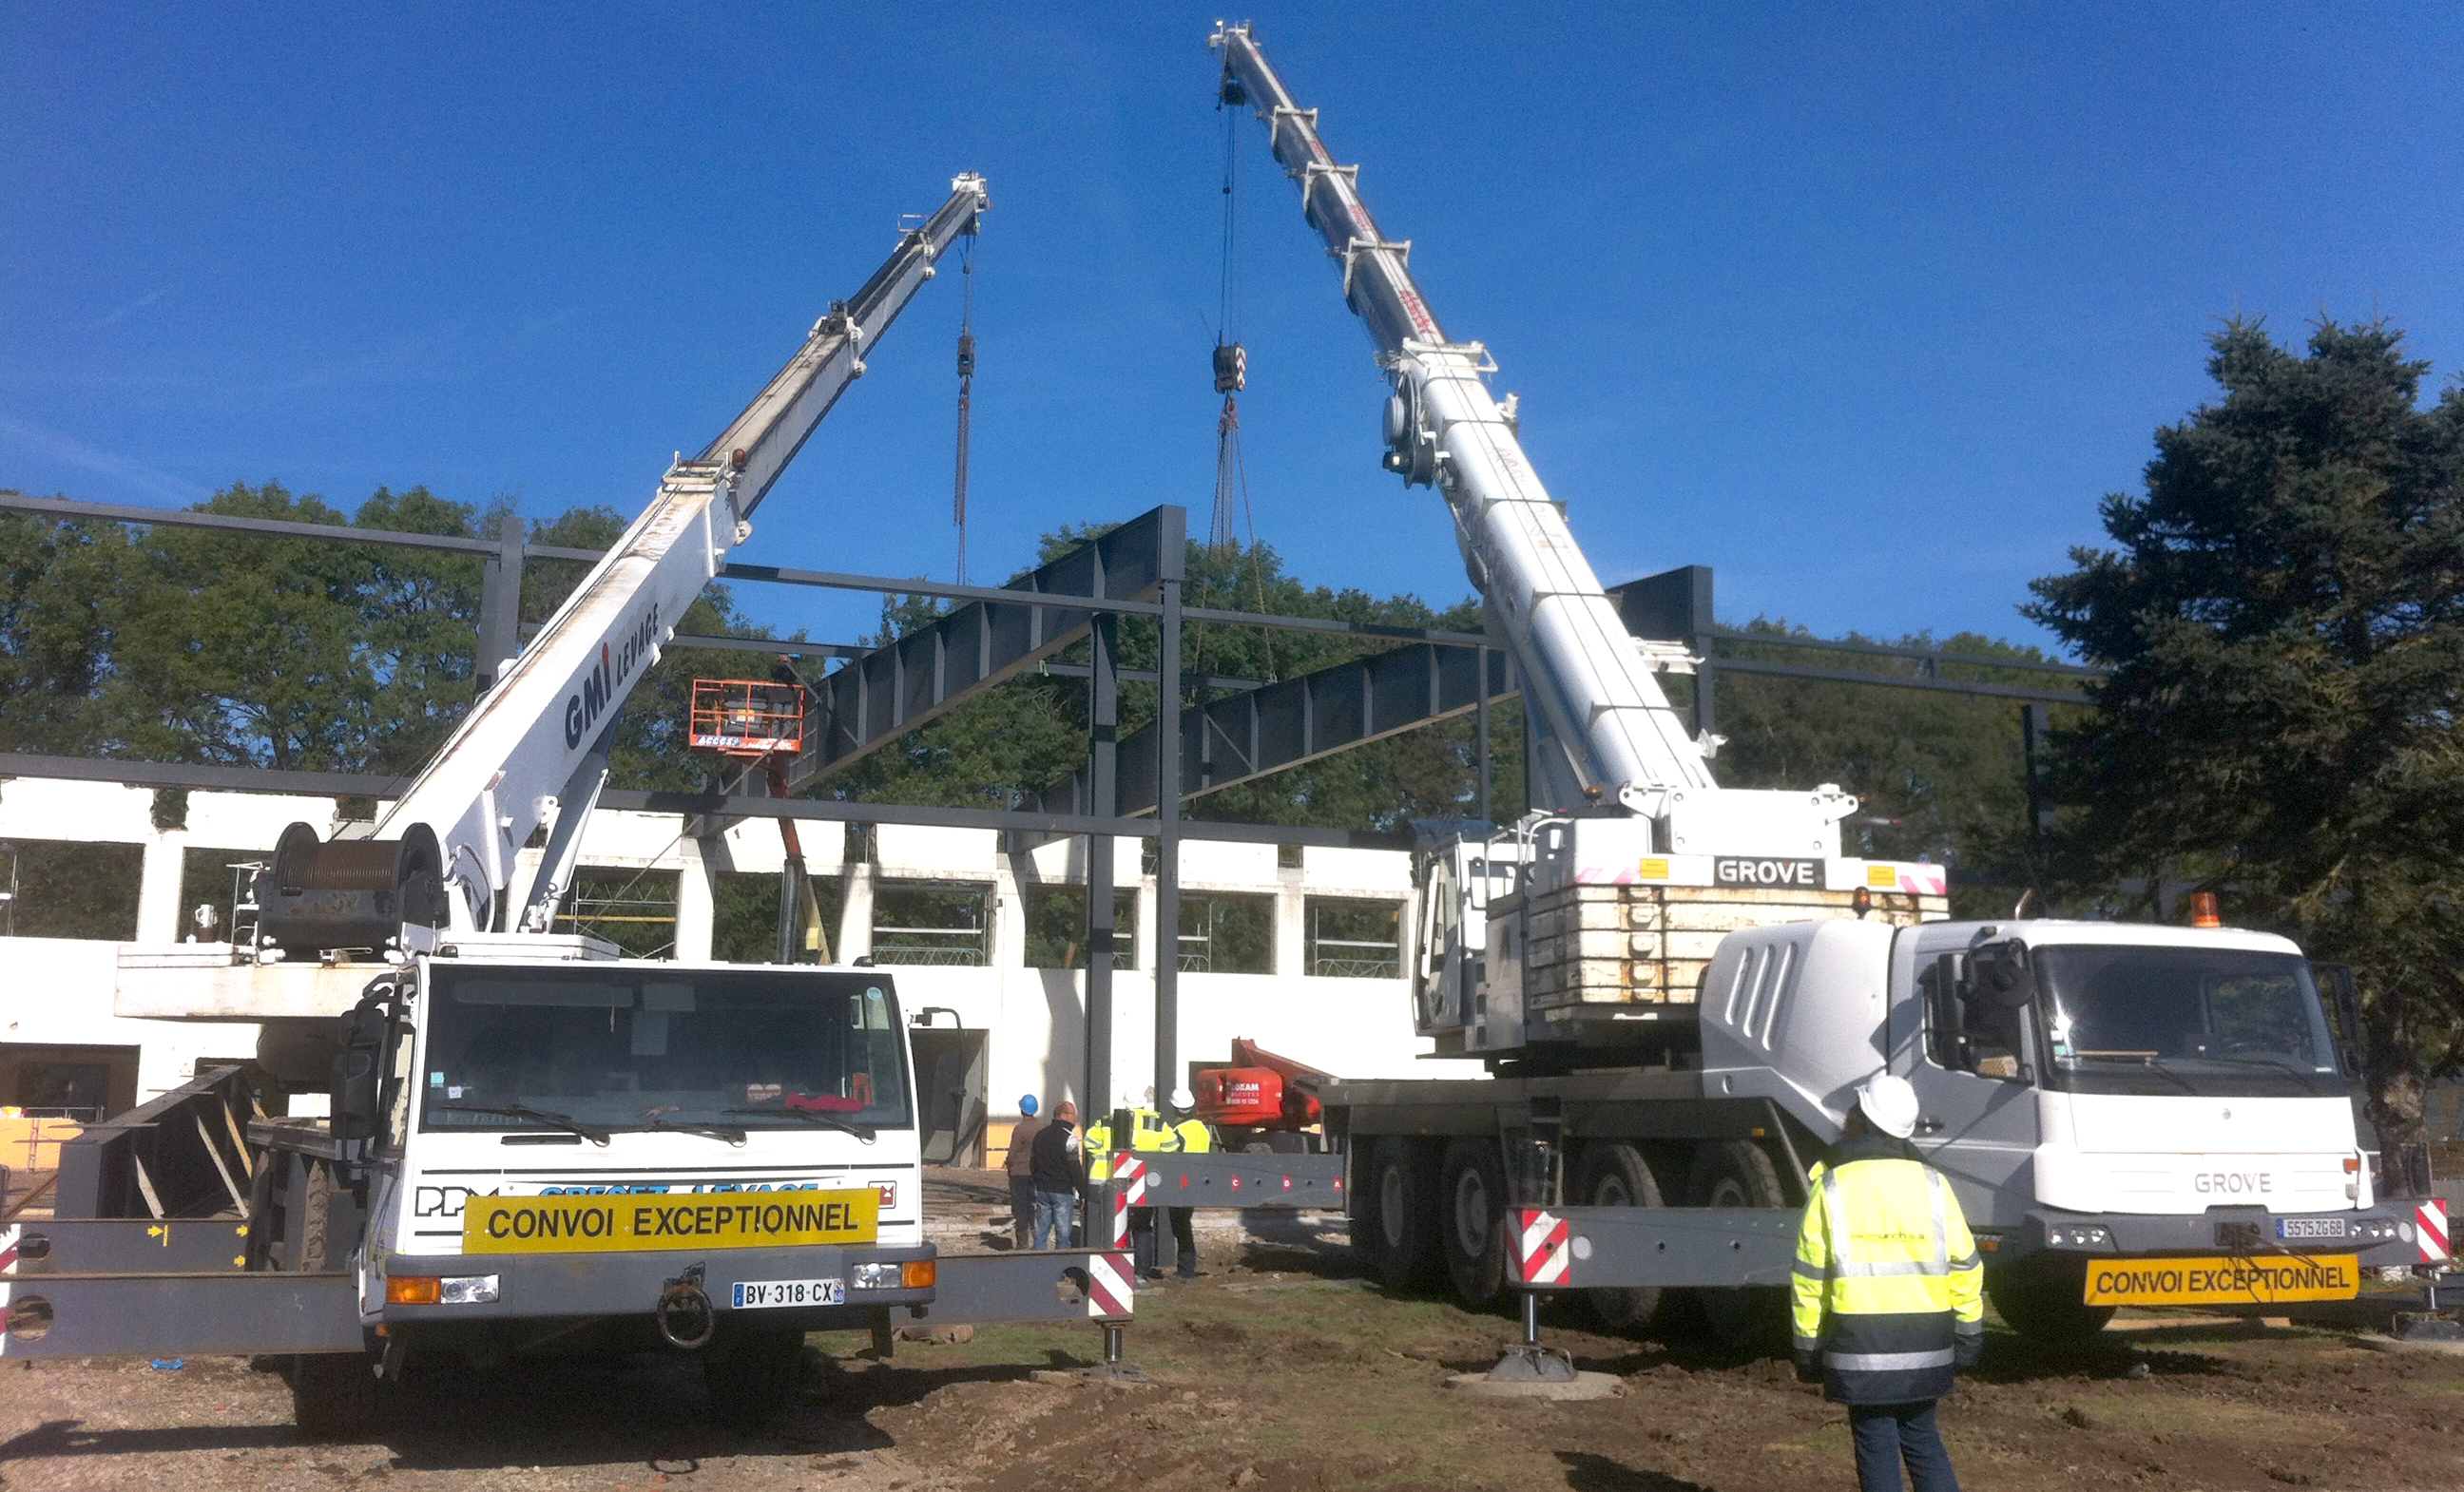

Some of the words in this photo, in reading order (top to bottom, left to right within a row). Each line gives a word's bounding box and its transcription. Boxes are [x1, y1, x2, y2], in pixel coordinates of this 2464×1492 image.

[616, 602, 660, 687] LEVAGE
[1718, 859, 1815, 885] GROVE
[2194, 1172, 2273, 1194] GROVE
[414, 1186, 500, 1217] PP
[488, 1207, 614, 1238] CONVOI
[633, 1203, 858, 1236] EXCEPTIONNEL
[2096, 1270, 2184, 1293] CONVOI
[2188, 1266, 2351, 1291] EXCEPTIONNEL
[745, 1282, 833, 1305] BV-318-CX
